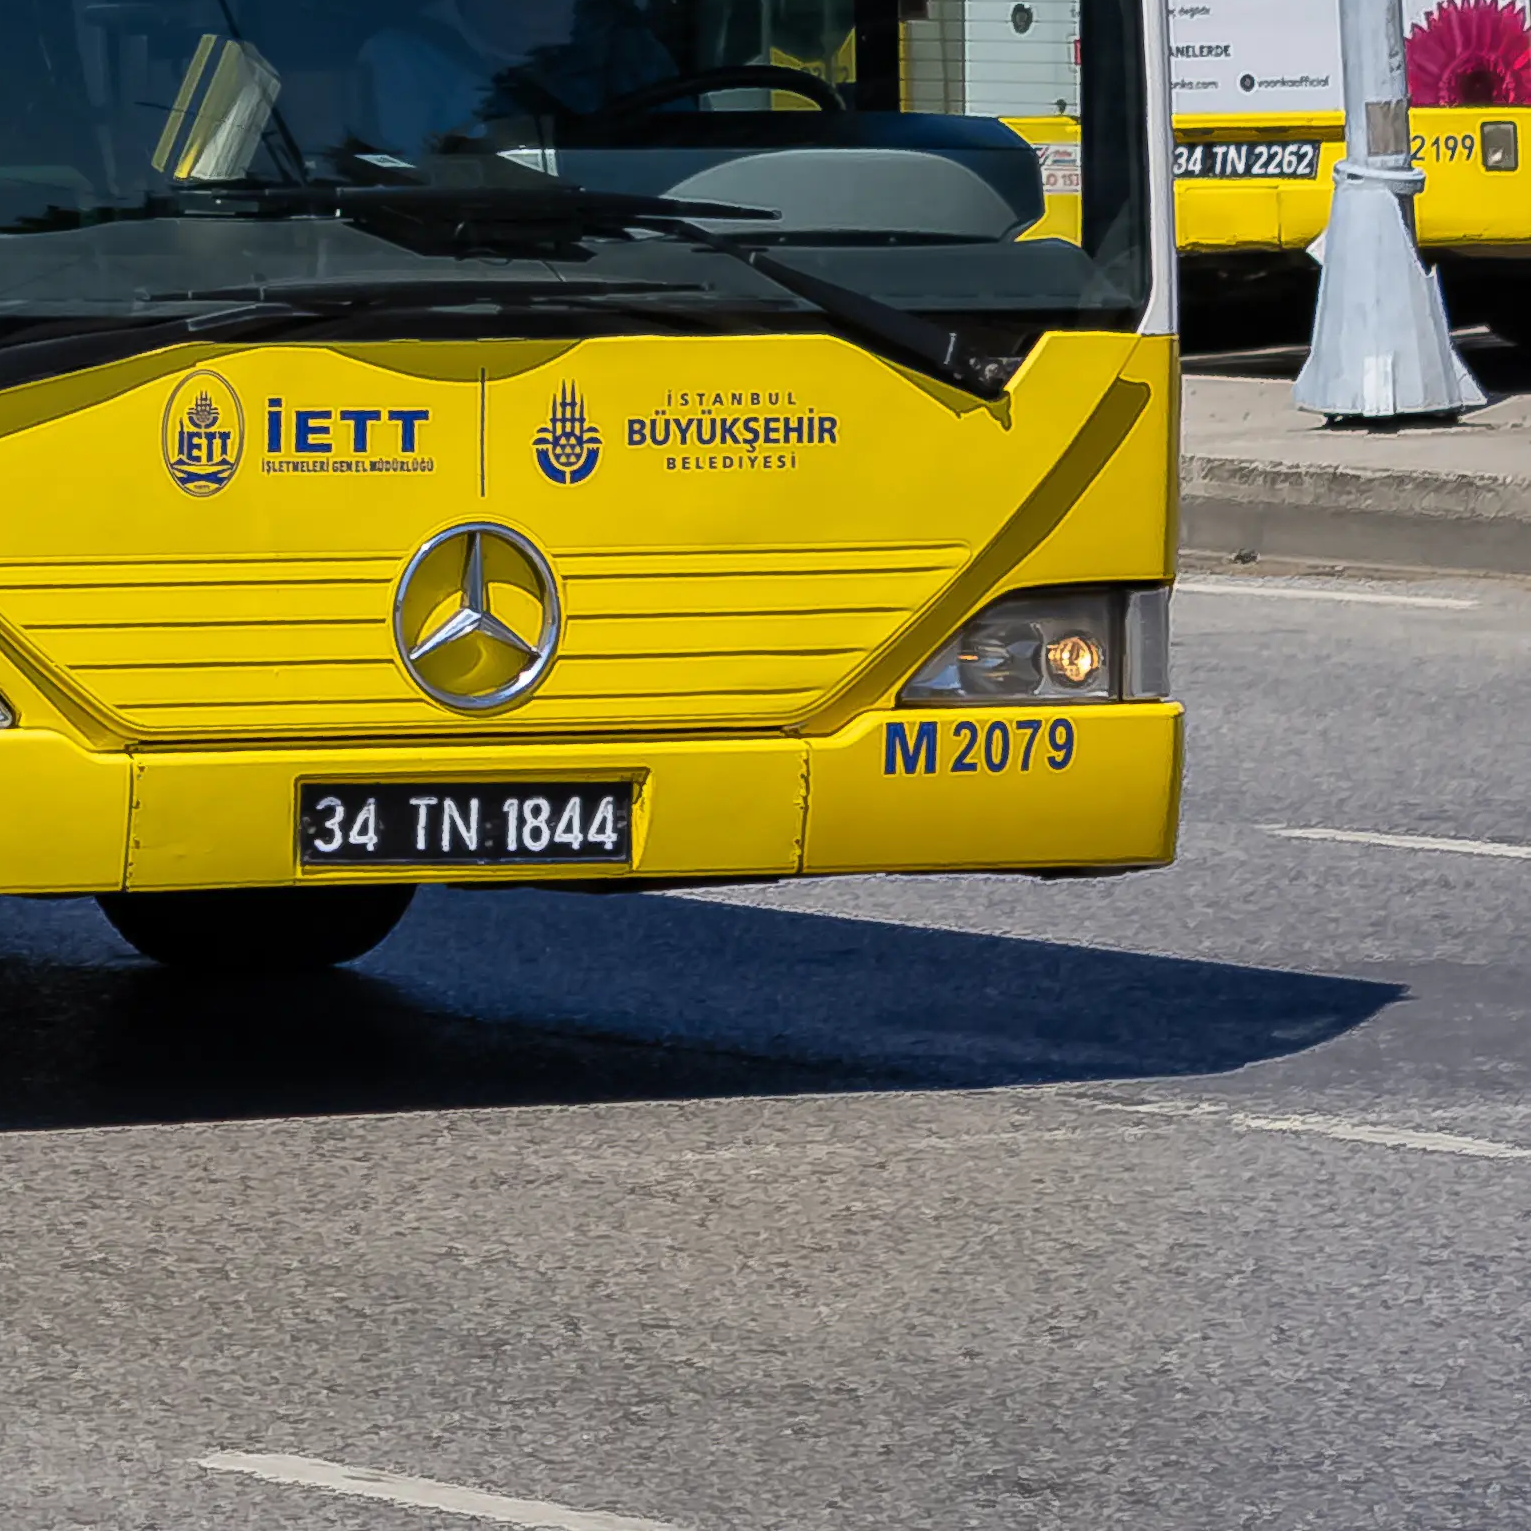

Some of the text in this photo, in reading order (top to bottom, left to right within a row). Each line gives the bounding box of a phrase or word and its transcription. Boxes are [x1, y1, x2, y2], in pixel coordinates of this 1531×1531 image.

[1173, 144, 1313, 174] 34 TN 2262
[1411, 135, 1475, 161] 2199
[667, 390, 797, 406] İSTANBUL
[267, 398, 430, 454] İETT
[627, 408, 837, 453] BÜYÜKŞEHİR
[884, 718, 1075, 775] M 2079
[313, 796, 618, 853] 34 TN 1844
